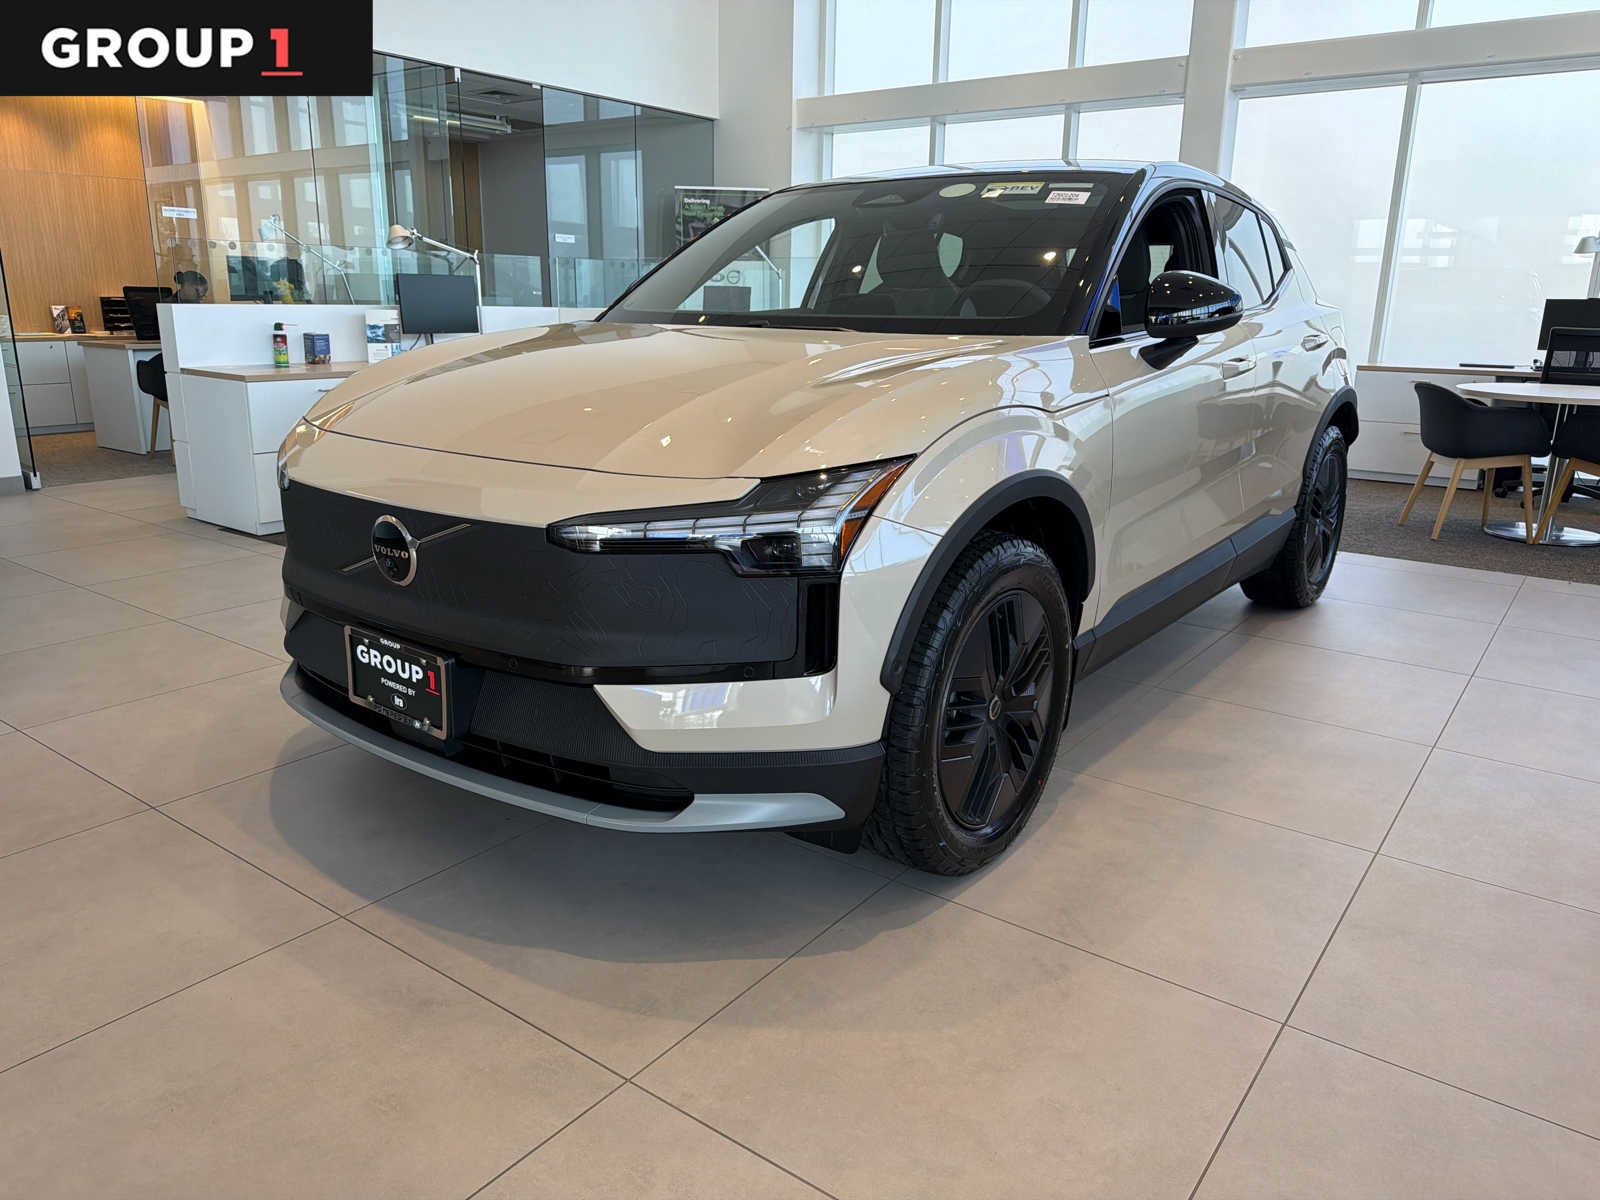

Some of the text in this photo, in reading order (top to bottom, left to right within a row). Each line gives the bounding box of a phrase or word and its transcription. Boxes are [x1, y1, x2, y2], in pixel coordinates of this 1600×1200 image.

[374, 544, 408, 559] VOLVO
[380, 638, 400, 649] GROUP
[357, 645, 423, 682] GROUP
[381, 678, 416, 696] POWERED BY
